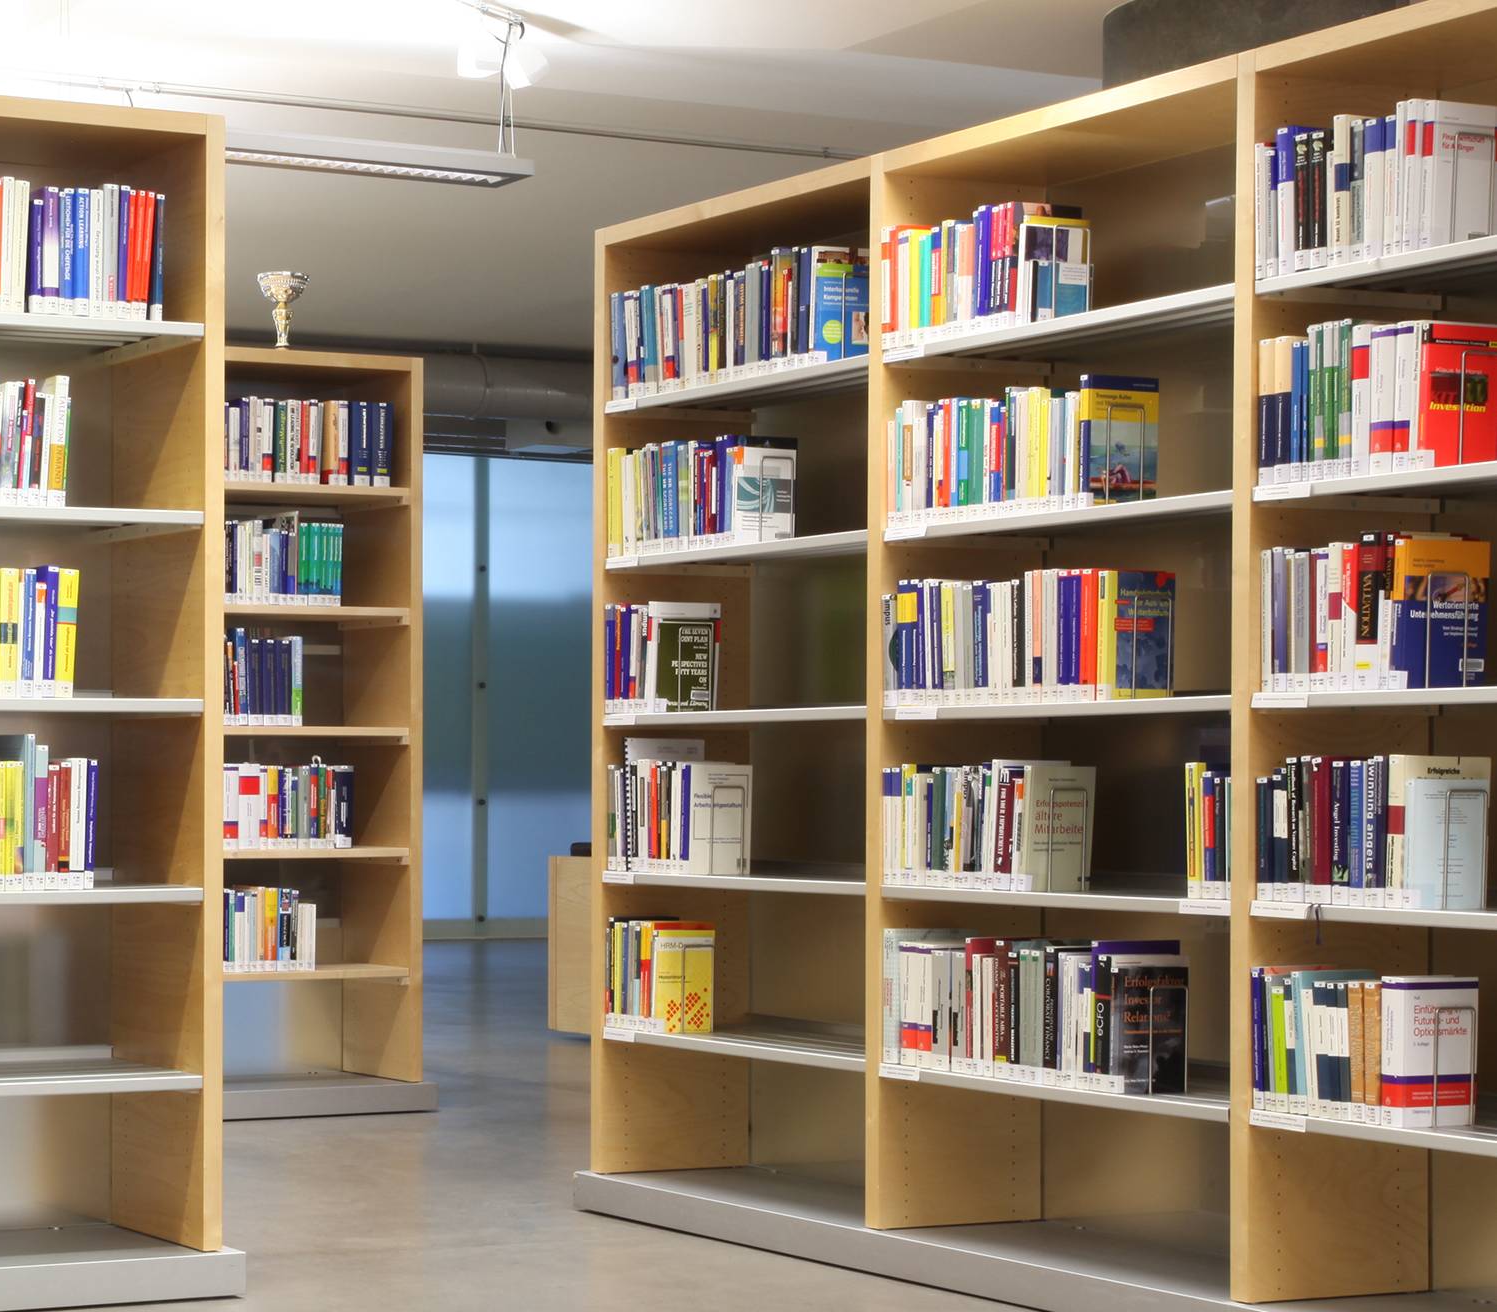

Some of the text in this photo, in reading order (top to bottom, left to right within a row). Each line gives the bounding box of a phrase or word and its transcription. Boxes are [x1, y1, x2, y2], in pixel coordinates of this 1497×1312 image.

[54, 445, 63, 484] DEMAND
[1361, 574, 1373, 637] VALUATION
[999, 788, 1007, 799] FOR
[997, 815, 1005, 855] IMPROVEMENT
[1331, 801, 1341, 861] Angel Investing
